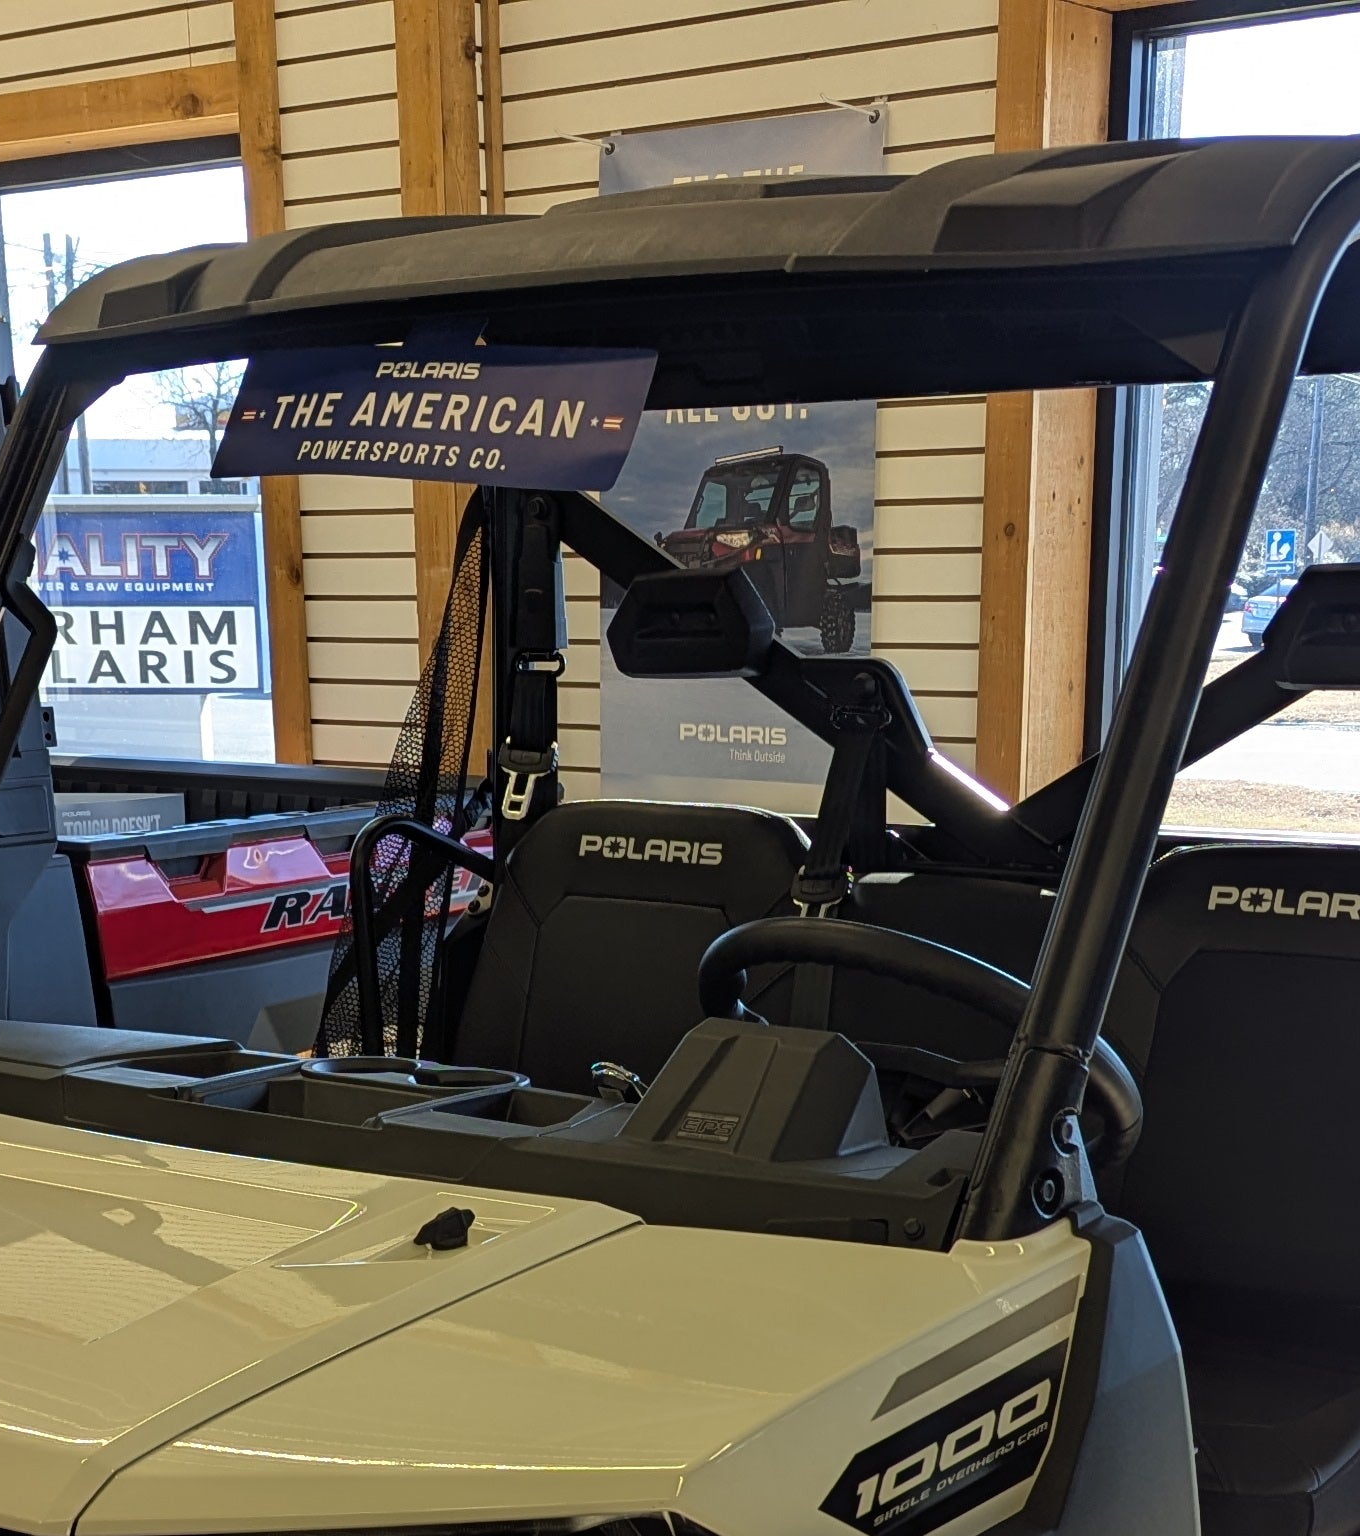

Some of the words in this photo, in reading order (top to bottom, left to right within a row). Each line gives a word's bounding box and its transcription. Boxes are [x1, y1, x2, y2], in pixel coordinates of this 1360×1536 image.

[375, 362, 482, 380] POLARIS
[272, 392, 343, 429] THE
[349, 391, 585, 439] AMERICAN
[297, 440, 461, 467] POWERSPORTS
[468, 447, 507, 471] CO.
[36, 533, 228, 579] ALITY
[32, 583, 64, 592] WER
[86, 583, 118, 592] SAW
[125, 583, 214, 592] EQUIPMENT
[53, 611, 237, 645] RHAM
[50, 650, 237, 684] LARIS
[679, 723, 787, 745] POLARIS
[729, 748, 752, 762] Think
[754, 750, 786, 764] Outside
[579, 835, 722, 866] POLARIS
[856, 1378, 1051, 1519] 1000
[873, 1488, 931, 1527] SINGLE
[936, 1441, 1015, 1492] OVERHEAD
[1017, 1421, 1049, 1445] CAM
